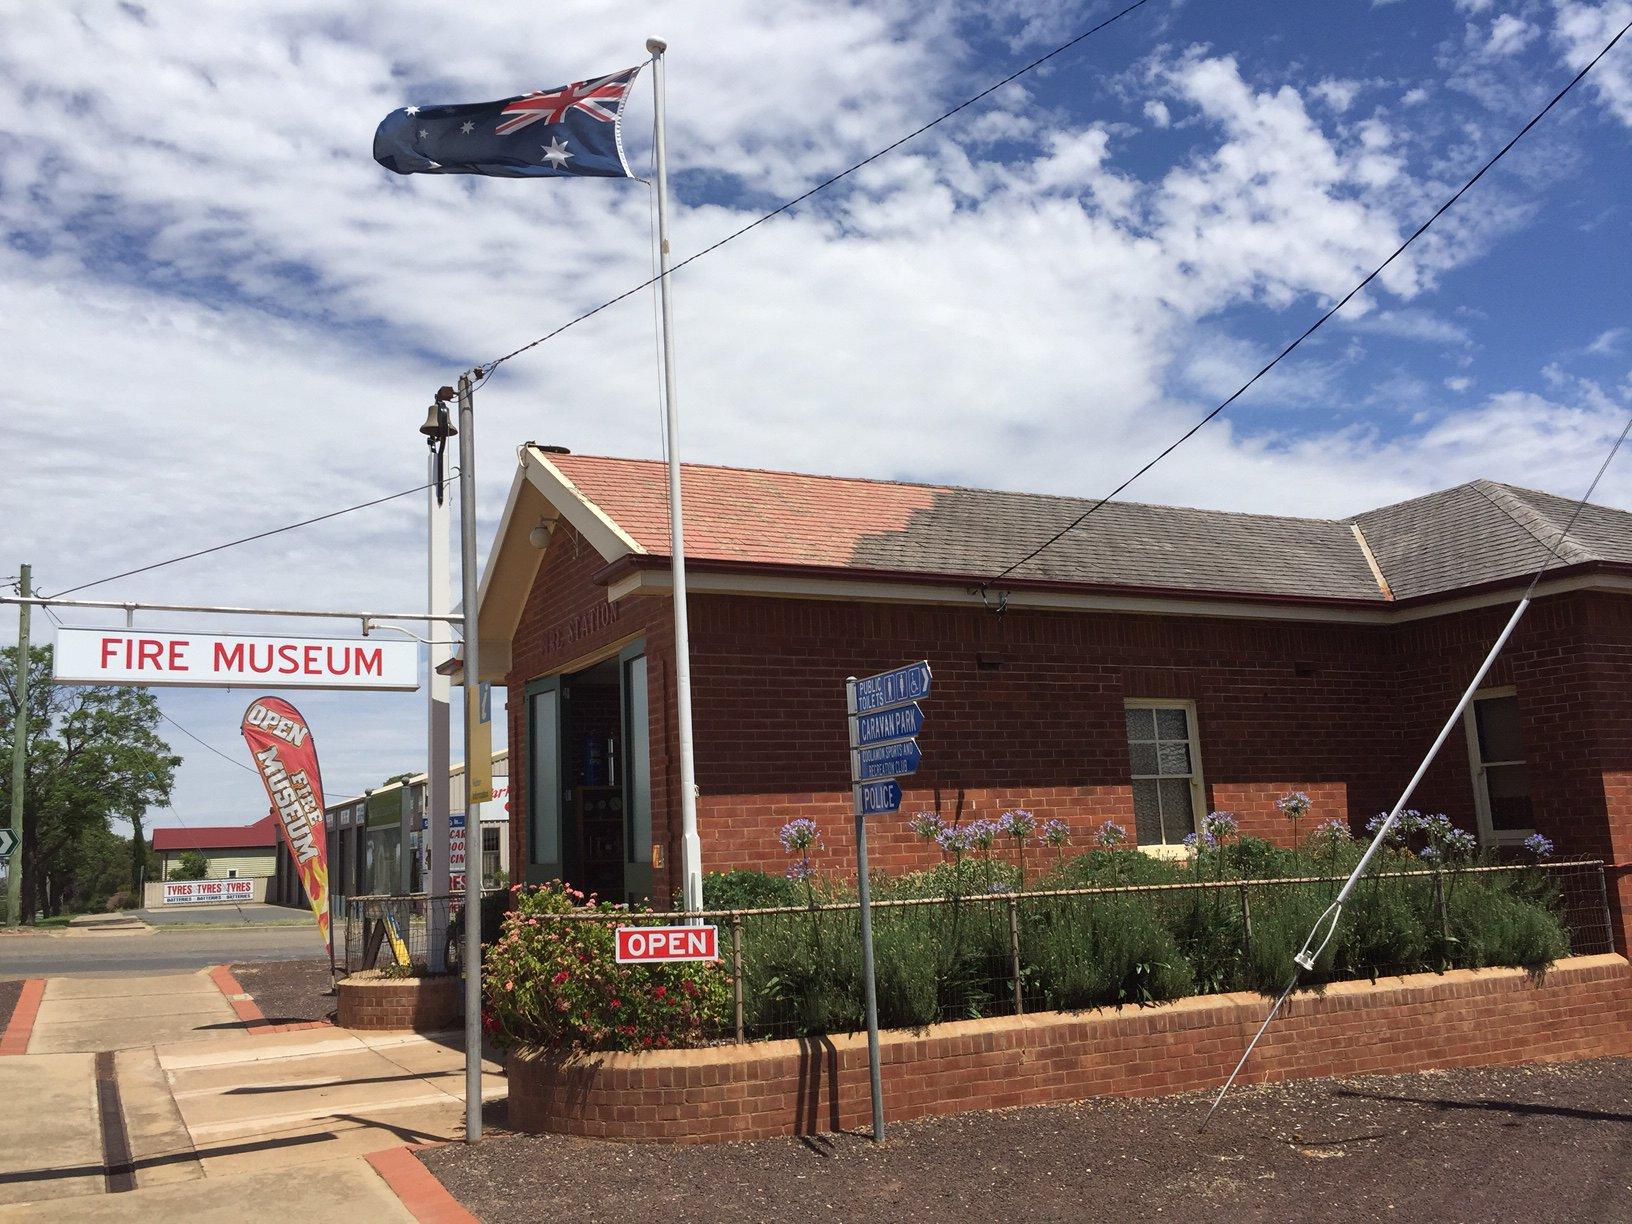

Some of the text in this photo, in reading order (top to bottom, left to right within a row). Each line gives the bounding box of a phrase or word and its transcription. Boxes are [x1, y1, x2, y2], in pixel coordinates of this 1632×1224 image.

[101, 637, 383, 676] FIRE MUSEUM
[859, 677, 882, 695] PUBLIC
[858, 691, 884, 710] TOILETS
[247, 703, 308, 747] OPEN
[861, 708, 917, 741] CARAVAN PARK
[885, 743, 903, 759] SPORTS
[903, 741, 914, 756] AND
[868, 759, 908, 777] RECREATION CLUB
[256, 745, 320, 864] MUSEUM
[289, 769, 323, 827] FIRE
[864, 784, 895, 810] POLICE
[167, 882, 251, 896] TYRES TYRES TYRES
[628, 932, 707, 957] OPEN
